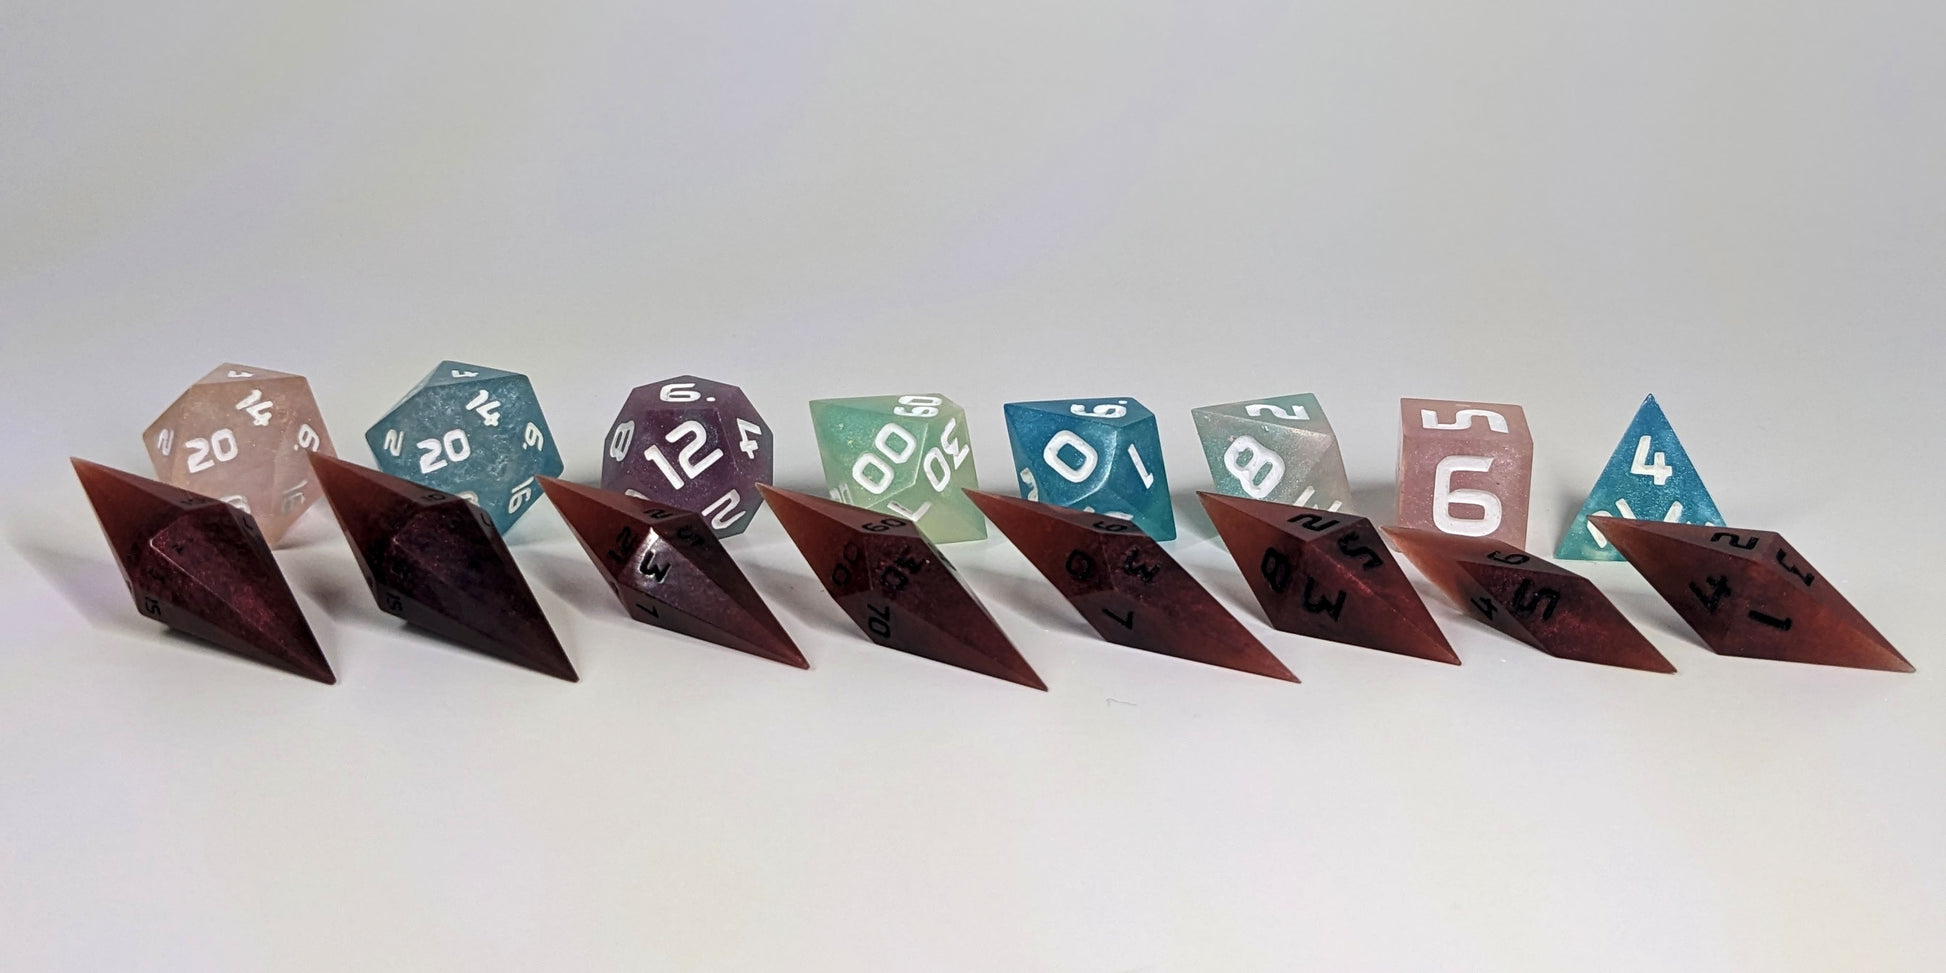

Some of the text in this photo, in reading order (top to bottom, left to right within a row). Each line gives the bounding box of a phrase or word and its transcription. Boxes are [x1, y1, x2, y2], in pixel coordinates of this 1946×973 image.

[235, 388, 274, 427] 14
[465, 389, 501, 427] 14
[1245, 404, 1310, 420] 2
[1420, 409, 1509, 434] 5
[157, 428, 175, 456] 2
[185, 428, 239, 474] 20
[383, 429, 404, 457] 2
[416, 428, 471, 474] 20
[610, 420, 635, 462] 8
[643, 420, 724, 490] 12
[736, 418, 762, 459] 4
[923, 418, 970, 493] 30
[1043, 430, 1098, 483] 0
[852, 423, 917, 494] 00
[1127, 443, 1154, 490] 1
[1223, 435, 1286, 499] 8
[1630, 435, 1673, 486] 4
[508, 476, 535, 514] 16
[643, 508, 673, 519] 2
[701, 489, 747, 530] 2
[1287, 504, 1340, 521] 2
[1432, 455, 1502, 537] 6
[608, 526, 639, 562] 12
[1338, 531, 1383, 568] 5
[1710, 532, 1759, 550] 2
[639, 550, 671, 582] 3
[1066, 549, 1092, 580] 0
[1123, 547, 1160, 583] 3
[1261, 547, 1291, 593] 8
[1775, 548, 1815, 586] 3
[1303, 577, 1346, 621] 3
[1471, 597, 1498, 621] 4
[1512, 578, 1561, 621] 5
[1688, 575, 1731, 612] 4
[867, 604, 891, 638] 70
[1102, 608, 1134, 630] 7
[1749, 610, 1792, 631] 1
